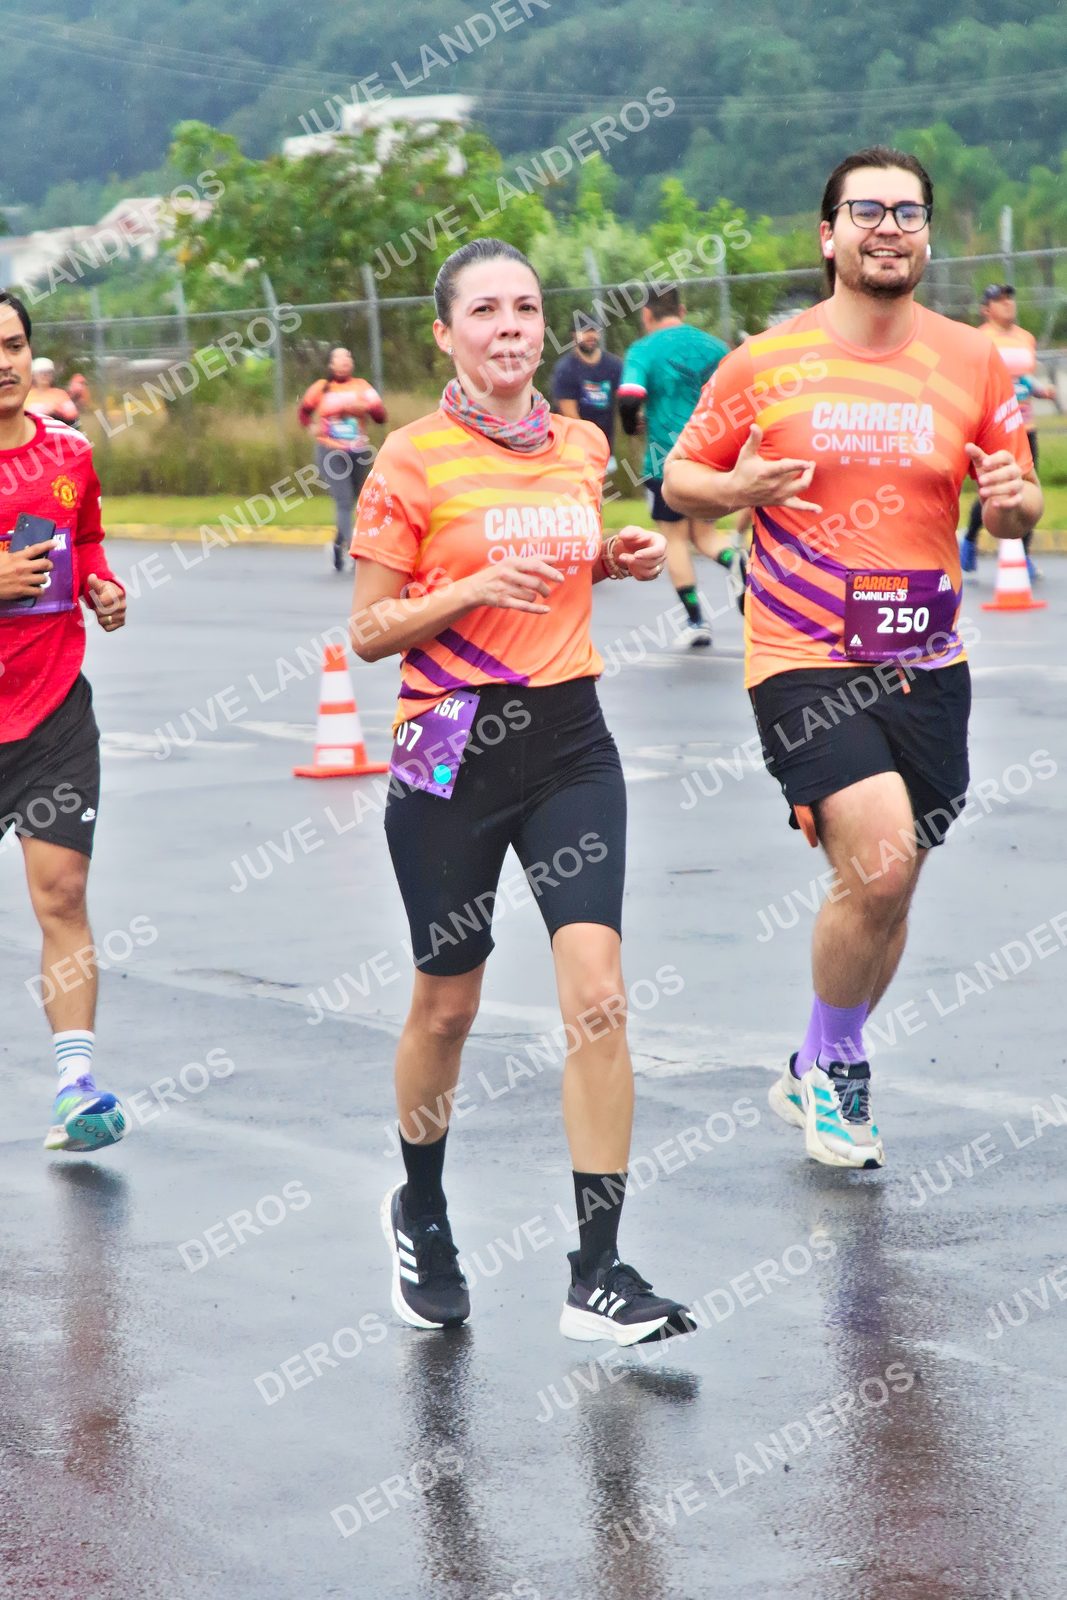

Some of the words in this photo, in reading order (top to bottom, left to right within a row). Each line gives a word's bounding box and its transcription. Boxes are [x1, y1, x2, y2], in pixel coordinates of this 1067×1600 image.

[811, 401, 934, 432] CARRERA
[484, 506, 599, 541] CARRERA
[853, 576, 909, 591] CARRERA
[877, 607, 930, 634] 250
